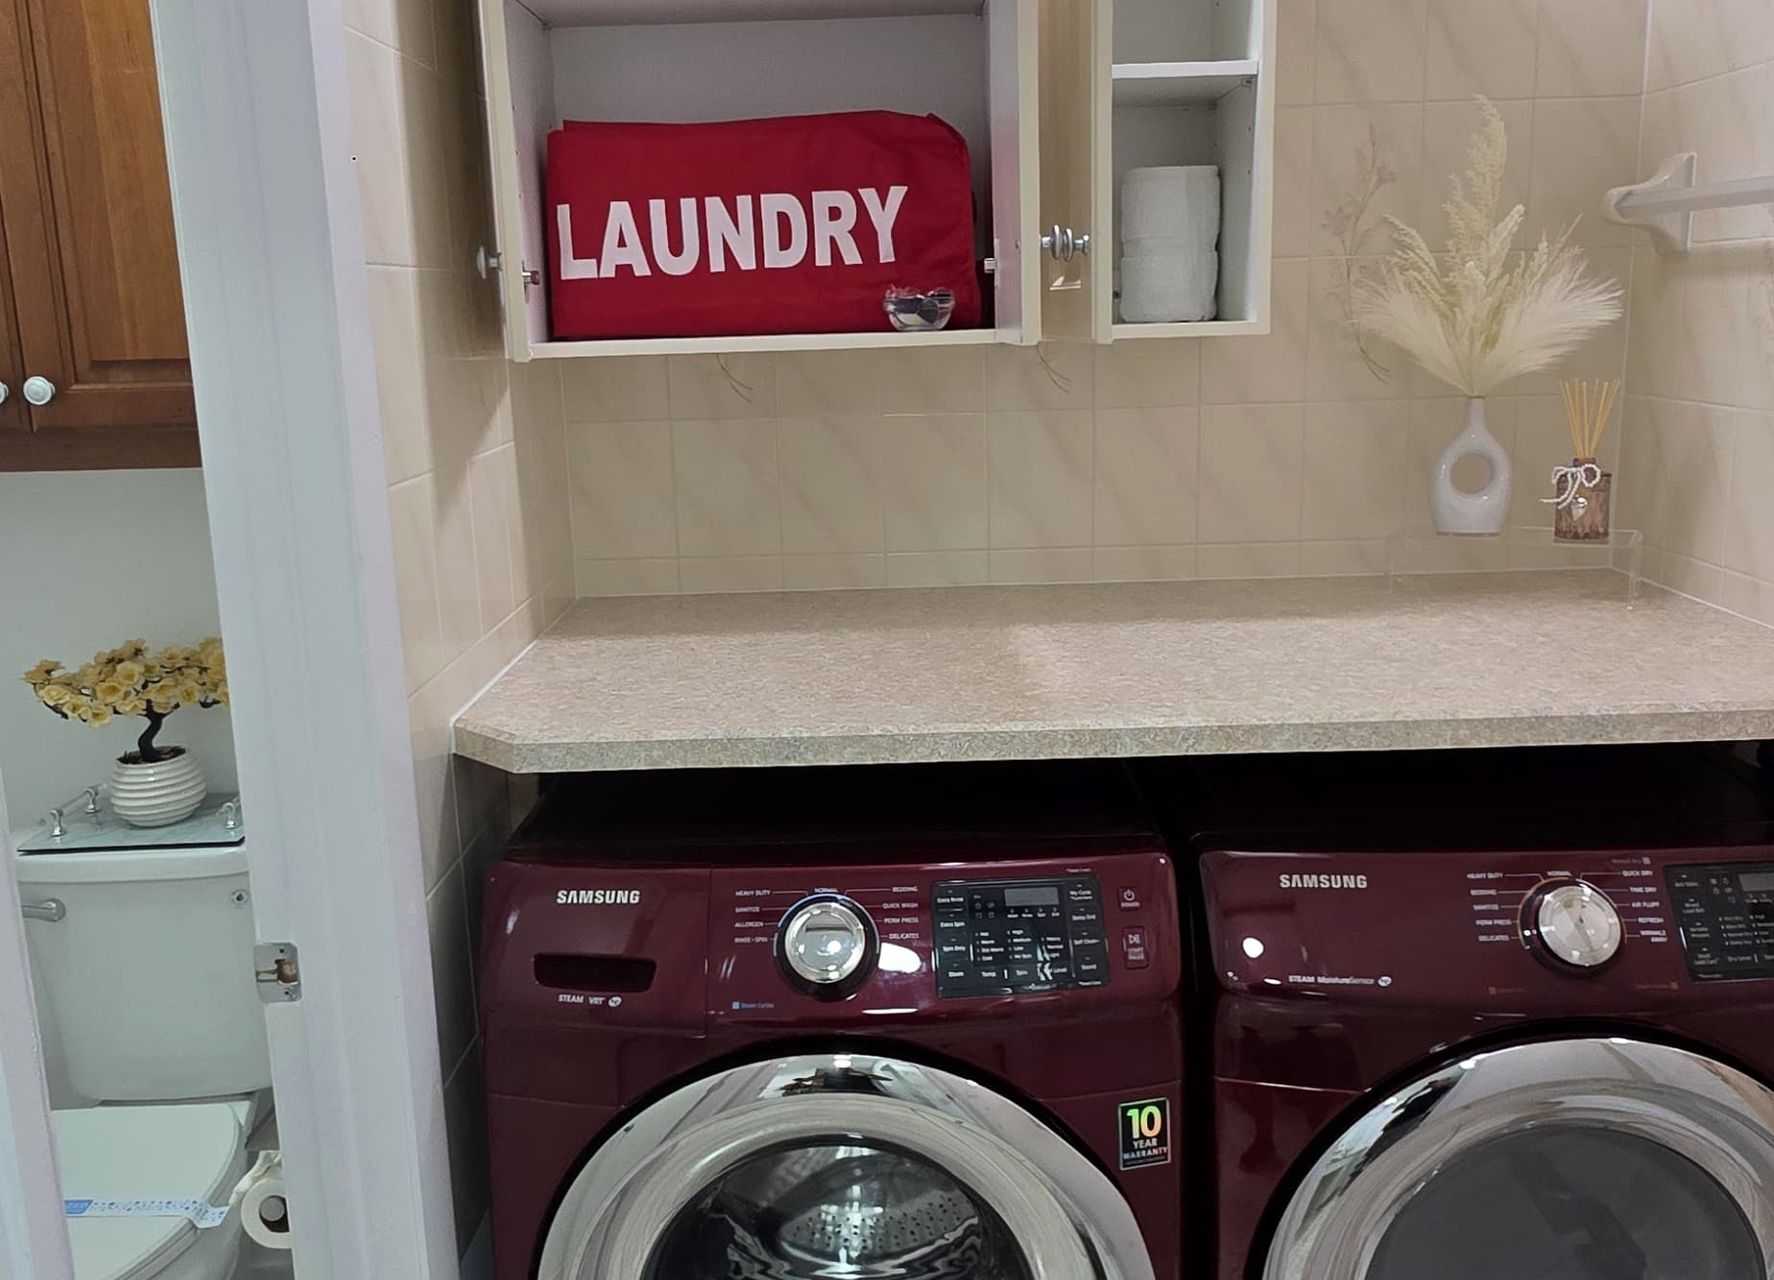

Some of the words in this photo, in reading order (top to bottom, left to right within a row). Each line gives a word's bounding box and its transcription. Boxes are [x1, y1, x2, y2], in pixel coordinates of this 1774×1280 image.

[556, 185, 908, 280] LAUNDRY
[1279, 874, 1368, 889] SAMSUNG
[556, 890, 641, 905] SAMSUNG
[1288, 975, 1315, 983] STEAM
[558, 994, 584, 1003] STEAM
[1126, 1105, 1162, 1139] 10
[1132, 1138, 1158, 1149] YEAR
[1123, 1146, 1168, 1160] WARRANTY
